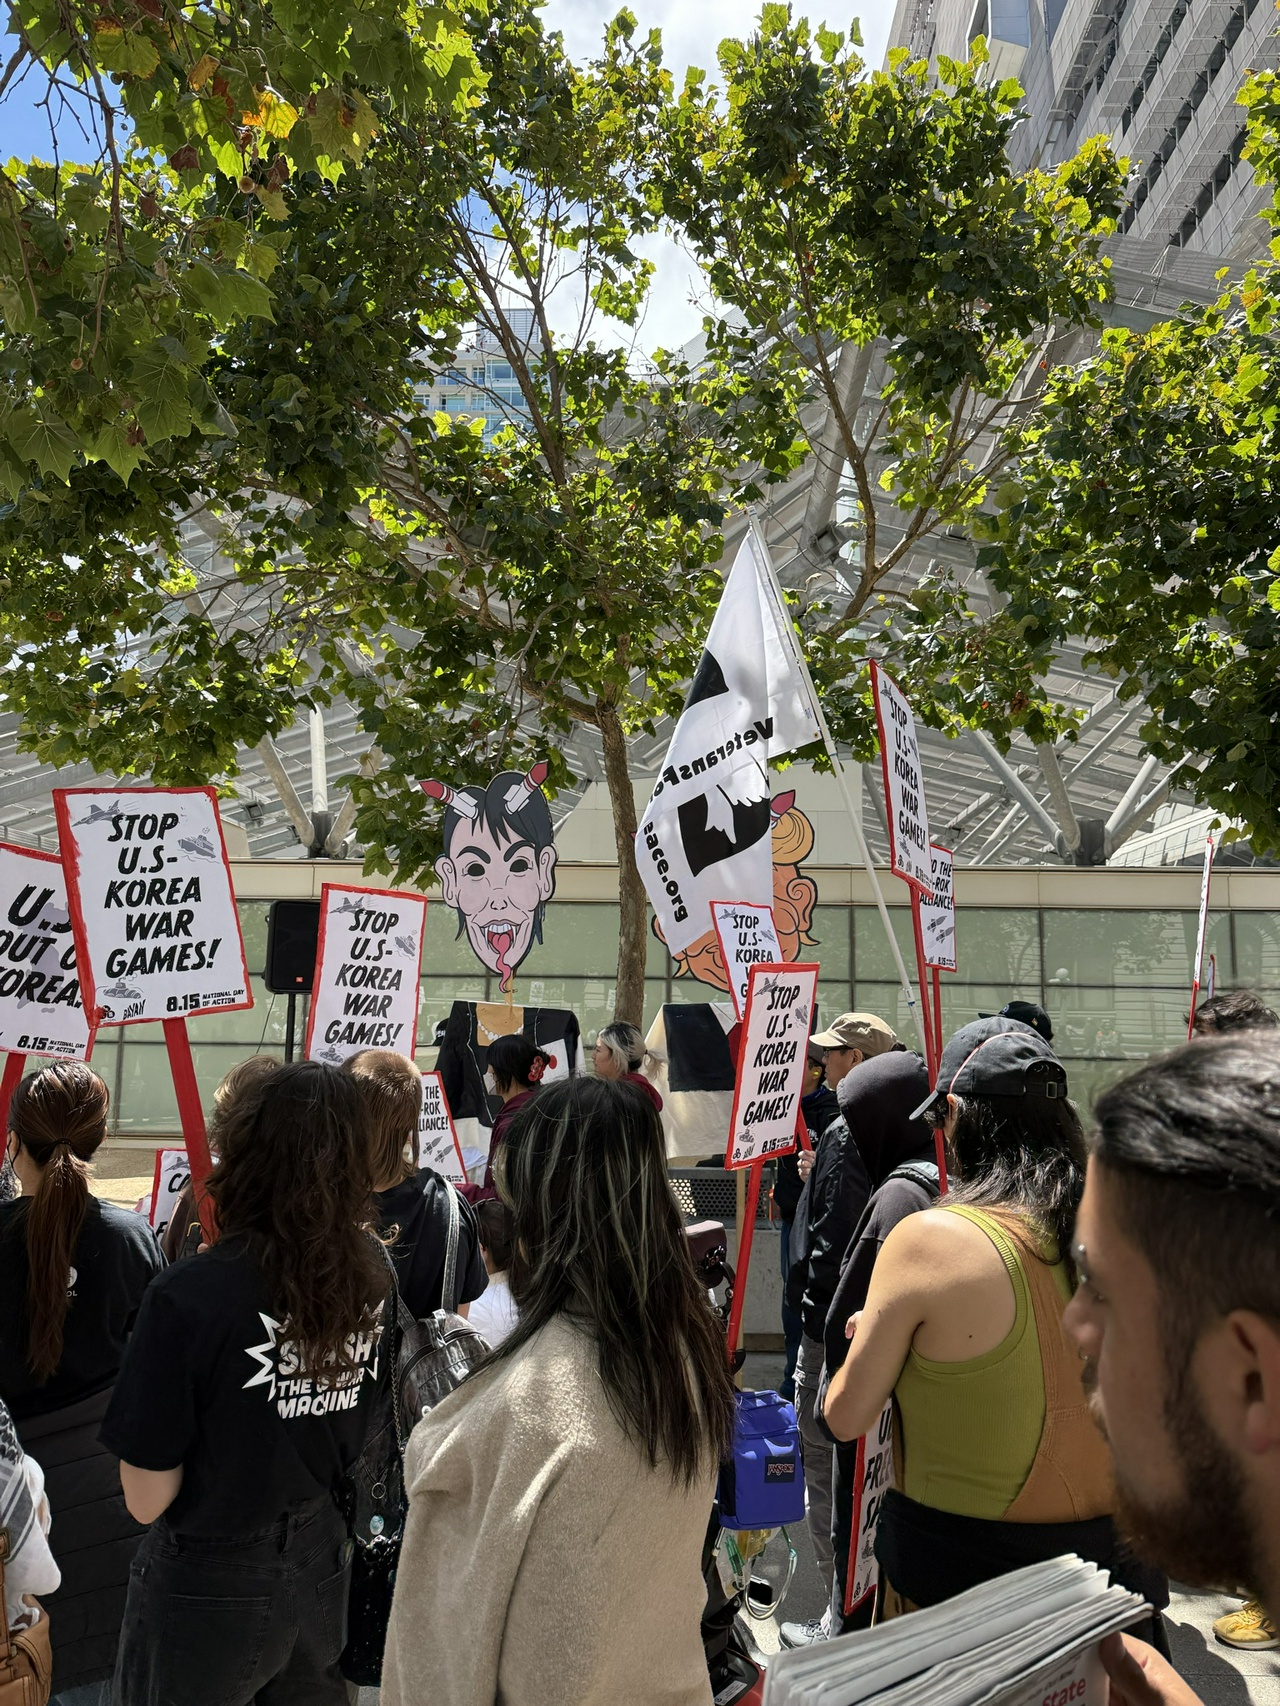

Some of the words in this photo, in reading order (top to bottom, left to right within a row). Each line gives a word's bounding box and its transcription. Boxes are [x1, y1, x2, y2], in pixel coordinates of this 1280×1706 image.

[890, 697, 908, 731] STOP
[895, 751, 919, 794] KOREA
[902, 784, 919, 820] WAR
[107, 813, 178, 842] STOP
[899, 810, 926, 853] GAMES!
[118, 845, 178, 874] U.S-
[940, 860, 952, 878] THE
[104, 876, 202, 909] KOREA
[932, 876, 950, 893] -ROK
[125, 909, 195, 942] WAR
[349, 909, 399, 936] STOP
[733, 914, 760, 929] STOP
[350, 937, 393, 962] U.S-
[738, 931, 762, 946] U.S-
[105, 938, 222, 978] GAMES!
[736, 948, 774, 963] KOREA
[334, 963, 402, 991] KOREA
[123, 999, 146, 1020] BAYAN
[166, 993, 200, 1012] 8.15
[202, 990, 232, 1000] NATIONAL
[212, 997, 236, 1006] ACTION
[342, 993, 393, 1019] WAR
[767, 985, 800, 1011] STOP
[324, 1020, 404, 1048] GAMES!
[766, 1013, 792, 1039] U.S-
[17, 1035, 49, 1051] 8.15
[49, 1040, 74, 1048] NATIONAL
[55, 1046, 76, 1054] ACTION
[753, 1041, 798, 1068] KOREA
[425, 1085, 440, 1100] THE
[757, 1068, 789, 1095] WAR
[421, 1101, 441, 1116] -ROK
[743, 1093, 795, 1126] GAMES!
[418, 1116, 449, 1132] LIANCE!
[761, 1138, 777, 1153] 8.15
[277, 1378, 312, 1397] THE
[277, 1385, 360, 1419] MACHINE
